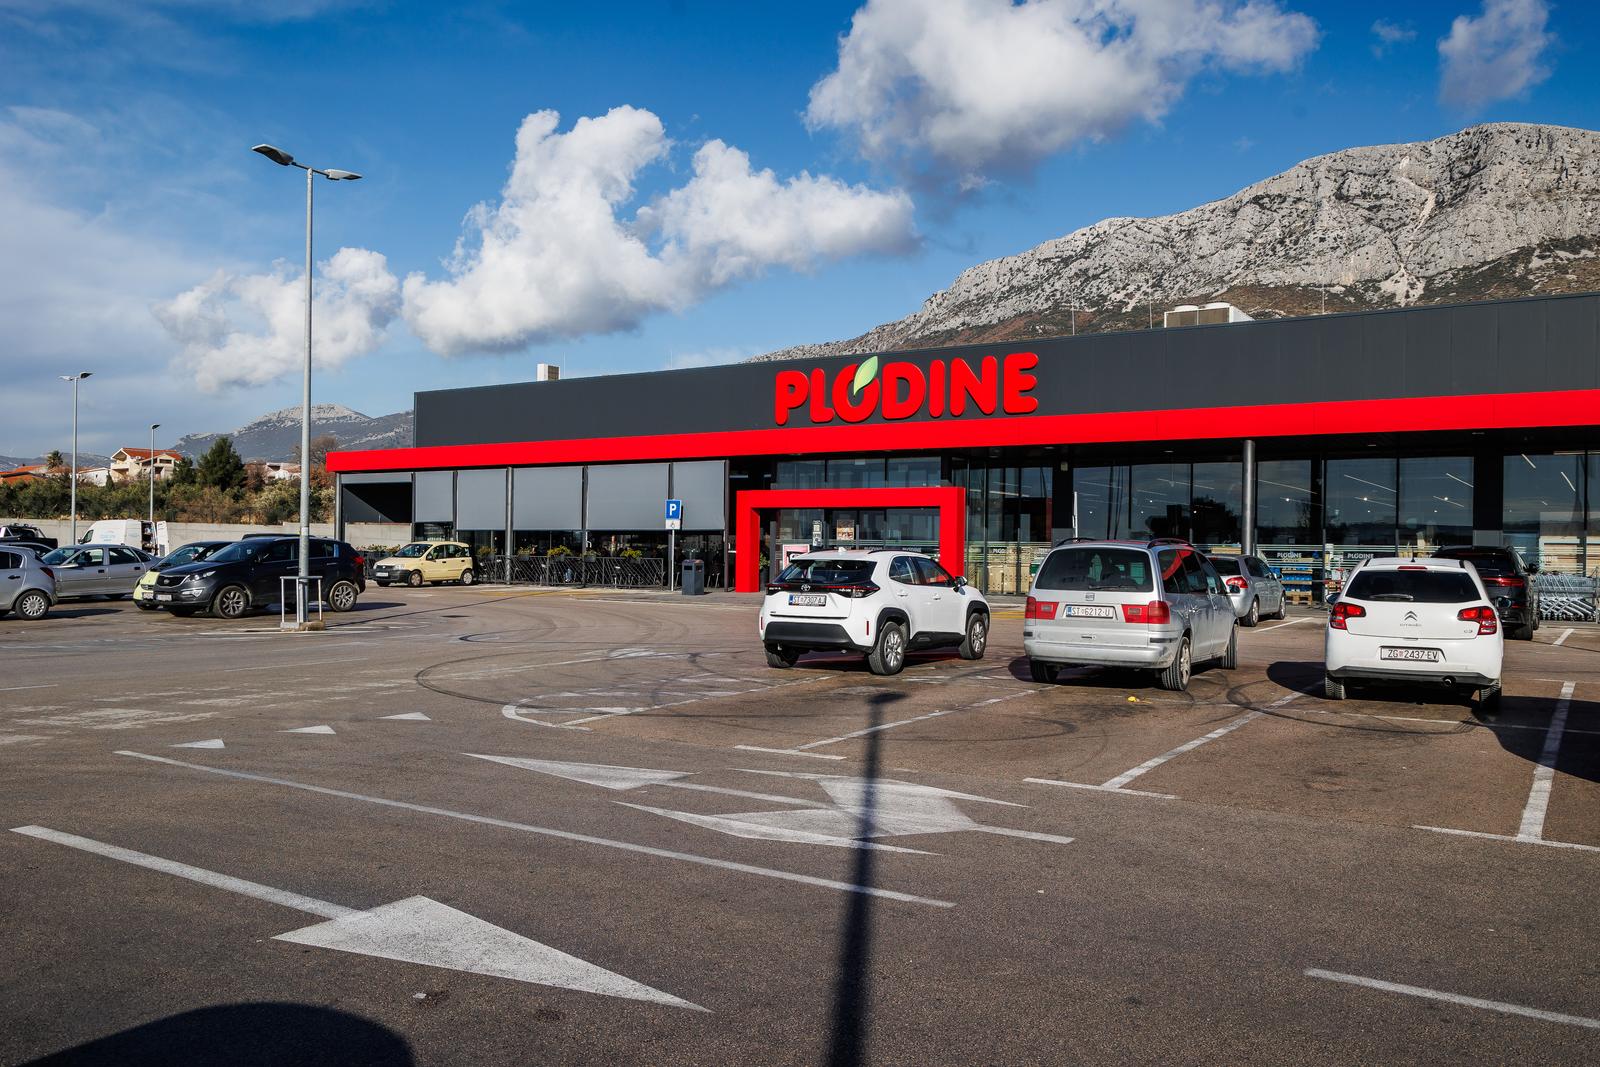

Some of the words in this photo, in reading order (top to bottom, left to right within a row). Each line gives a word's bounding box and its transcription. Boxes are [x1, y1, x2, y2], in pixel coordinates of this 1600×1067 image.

[775, 352, 1039, 426] PLODINE
[669, 503, 677, 516] P
[1072, 606, 1080, 615] ST
[1388, 649, 1398, 658] ZG
